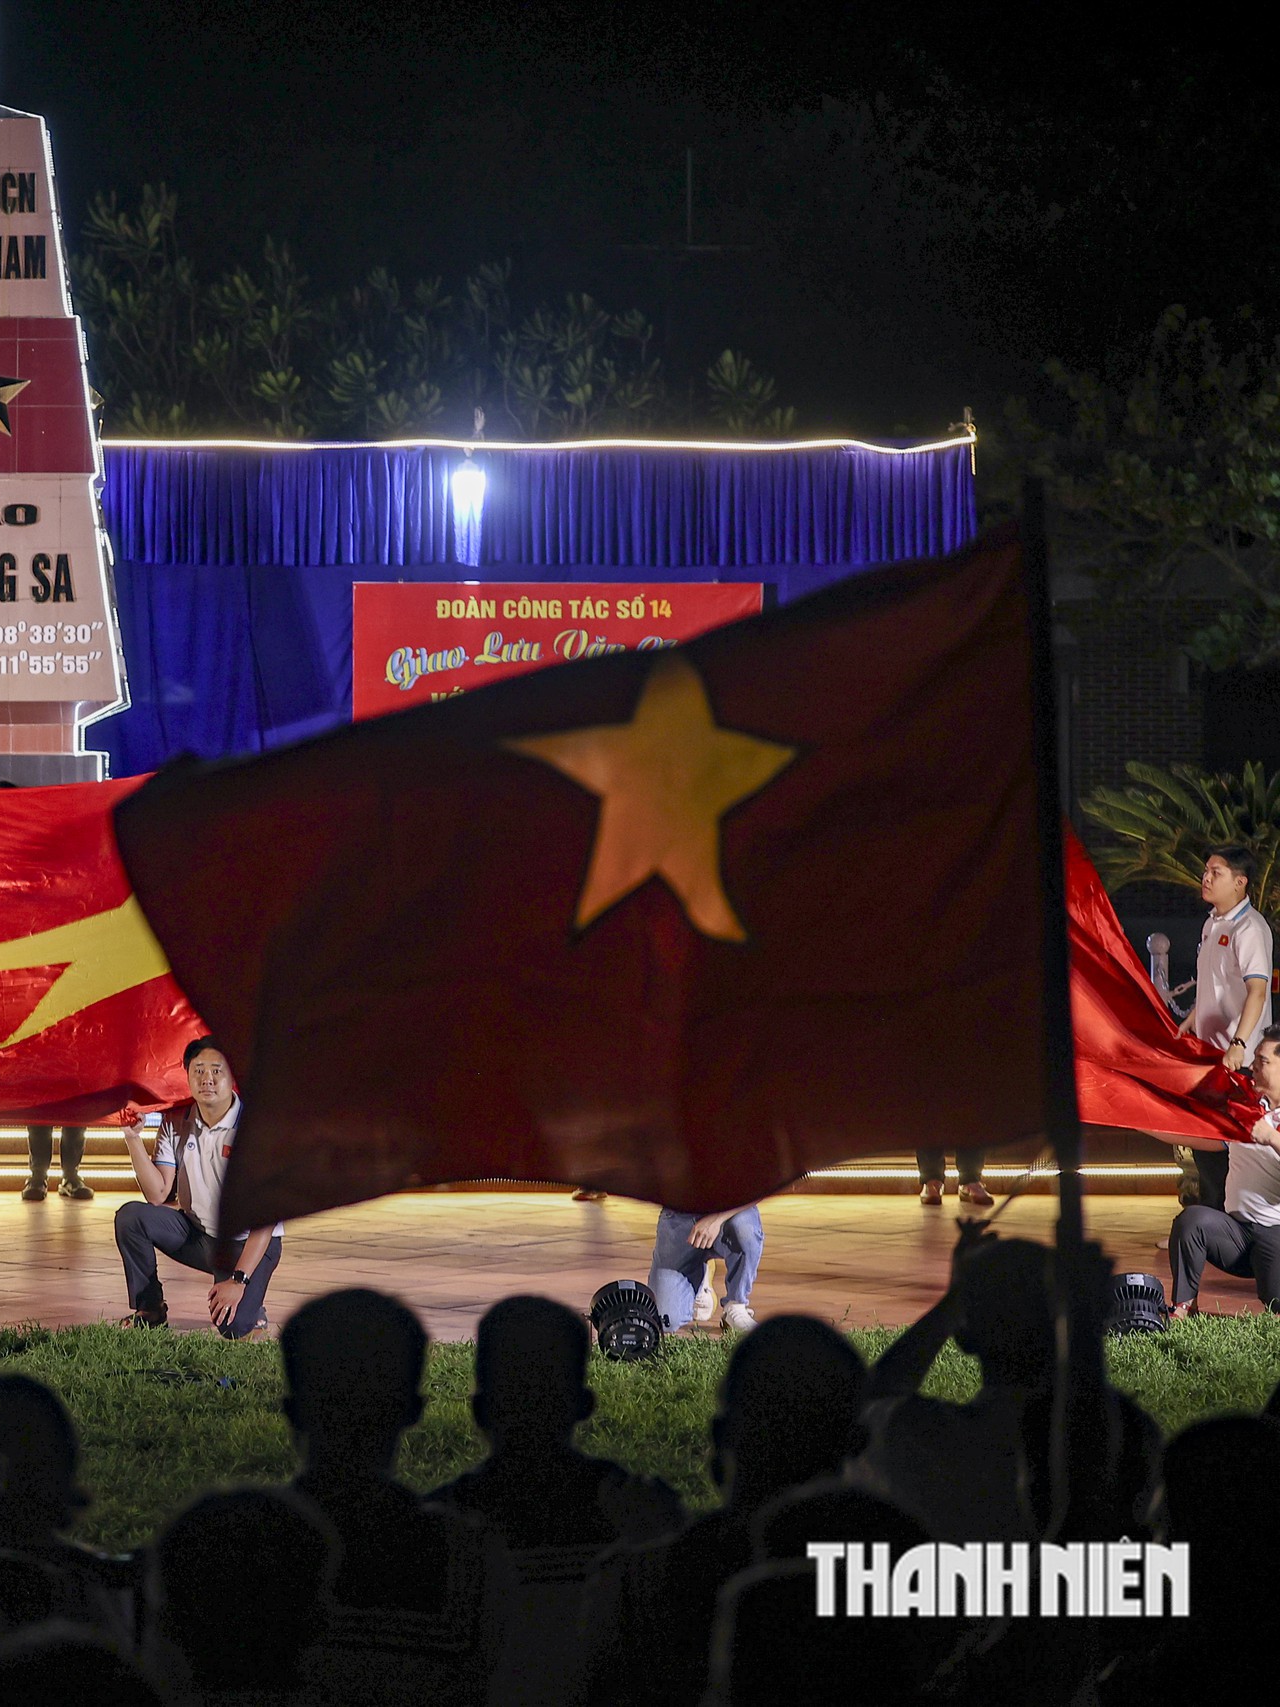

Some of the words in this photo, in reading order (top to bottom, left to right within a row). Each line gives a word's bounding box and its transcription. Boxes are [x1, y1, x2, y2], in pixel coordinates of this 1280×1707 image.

[30, 552, 77, 603] SA
[436, 595, 496, 619] ĐOÀN
[502, 595, 563, 619] CÔNG
[568, 596, 610, 619] TÁC
[616, 593, 645, 619] SỐ
[649, 599, 673, 618] 14
[384, 646, 470, 691] Giao
[474, 631, 544, 666] Lưu
